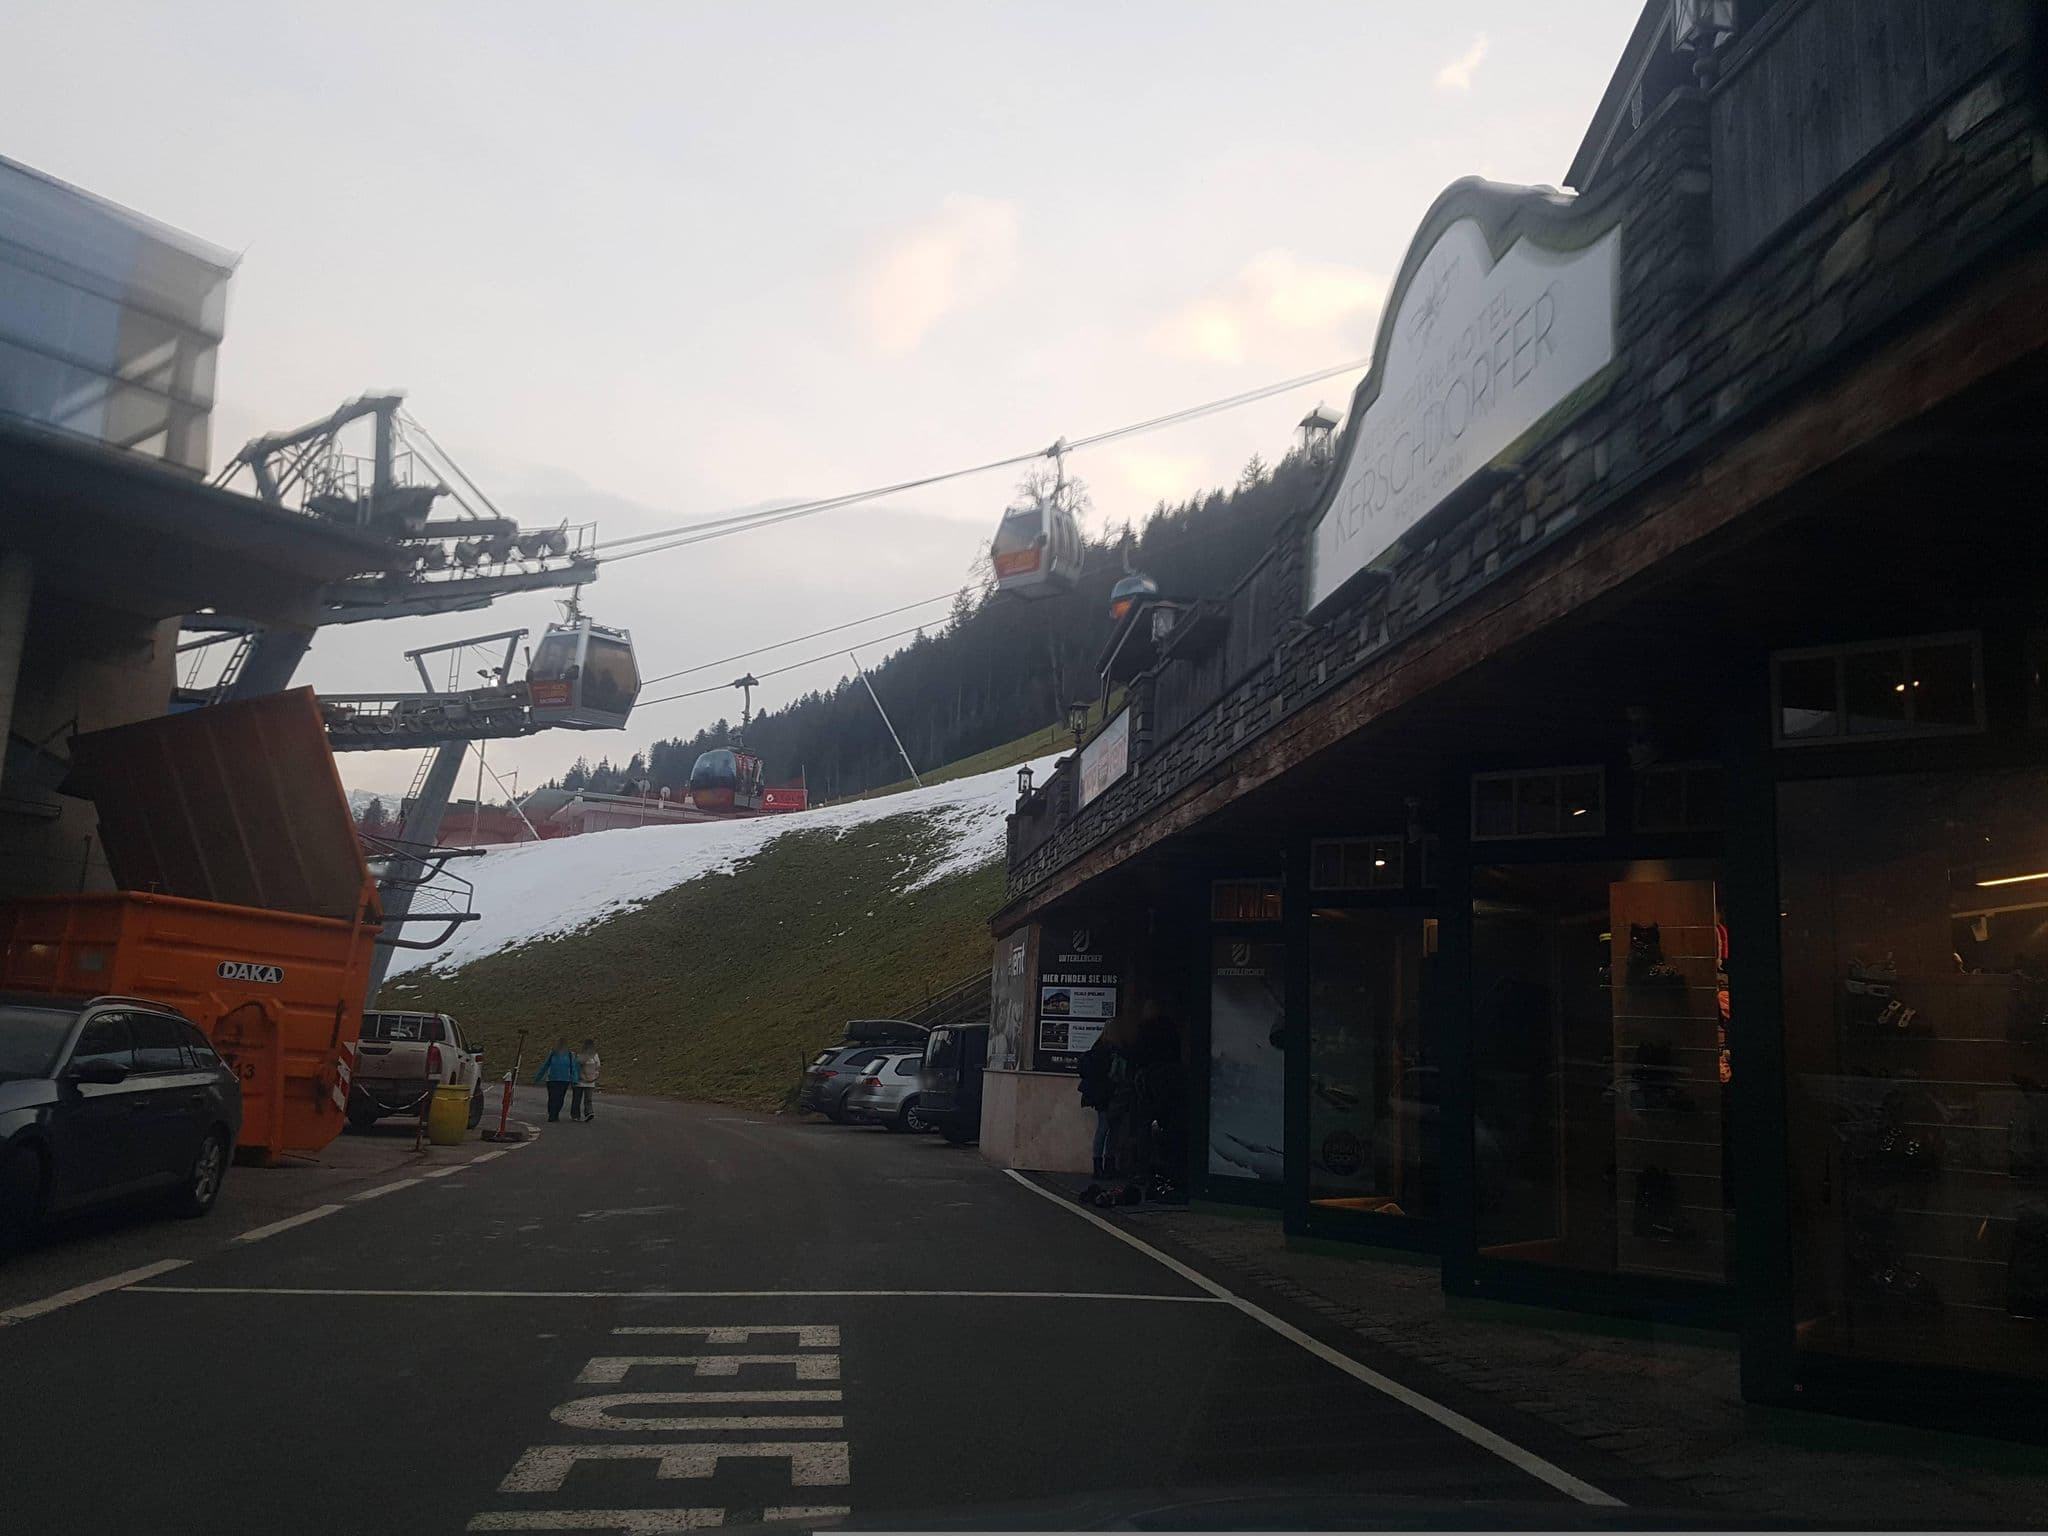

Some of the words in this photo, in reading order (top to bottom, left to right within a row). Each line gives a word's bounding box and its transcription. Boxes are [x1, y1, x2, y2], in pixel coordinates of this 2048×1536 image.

[1335, 280, 1563, 553] KERSCHDORFER
[222, 961, 278, 984] DAKA
[1042, 974, 1059, 983] HIER
[1061, 974, 1087, 984] FINDEN
[1089, 975, 1101, 984] SIE
[1102, 975, 1118, 984] UNS
